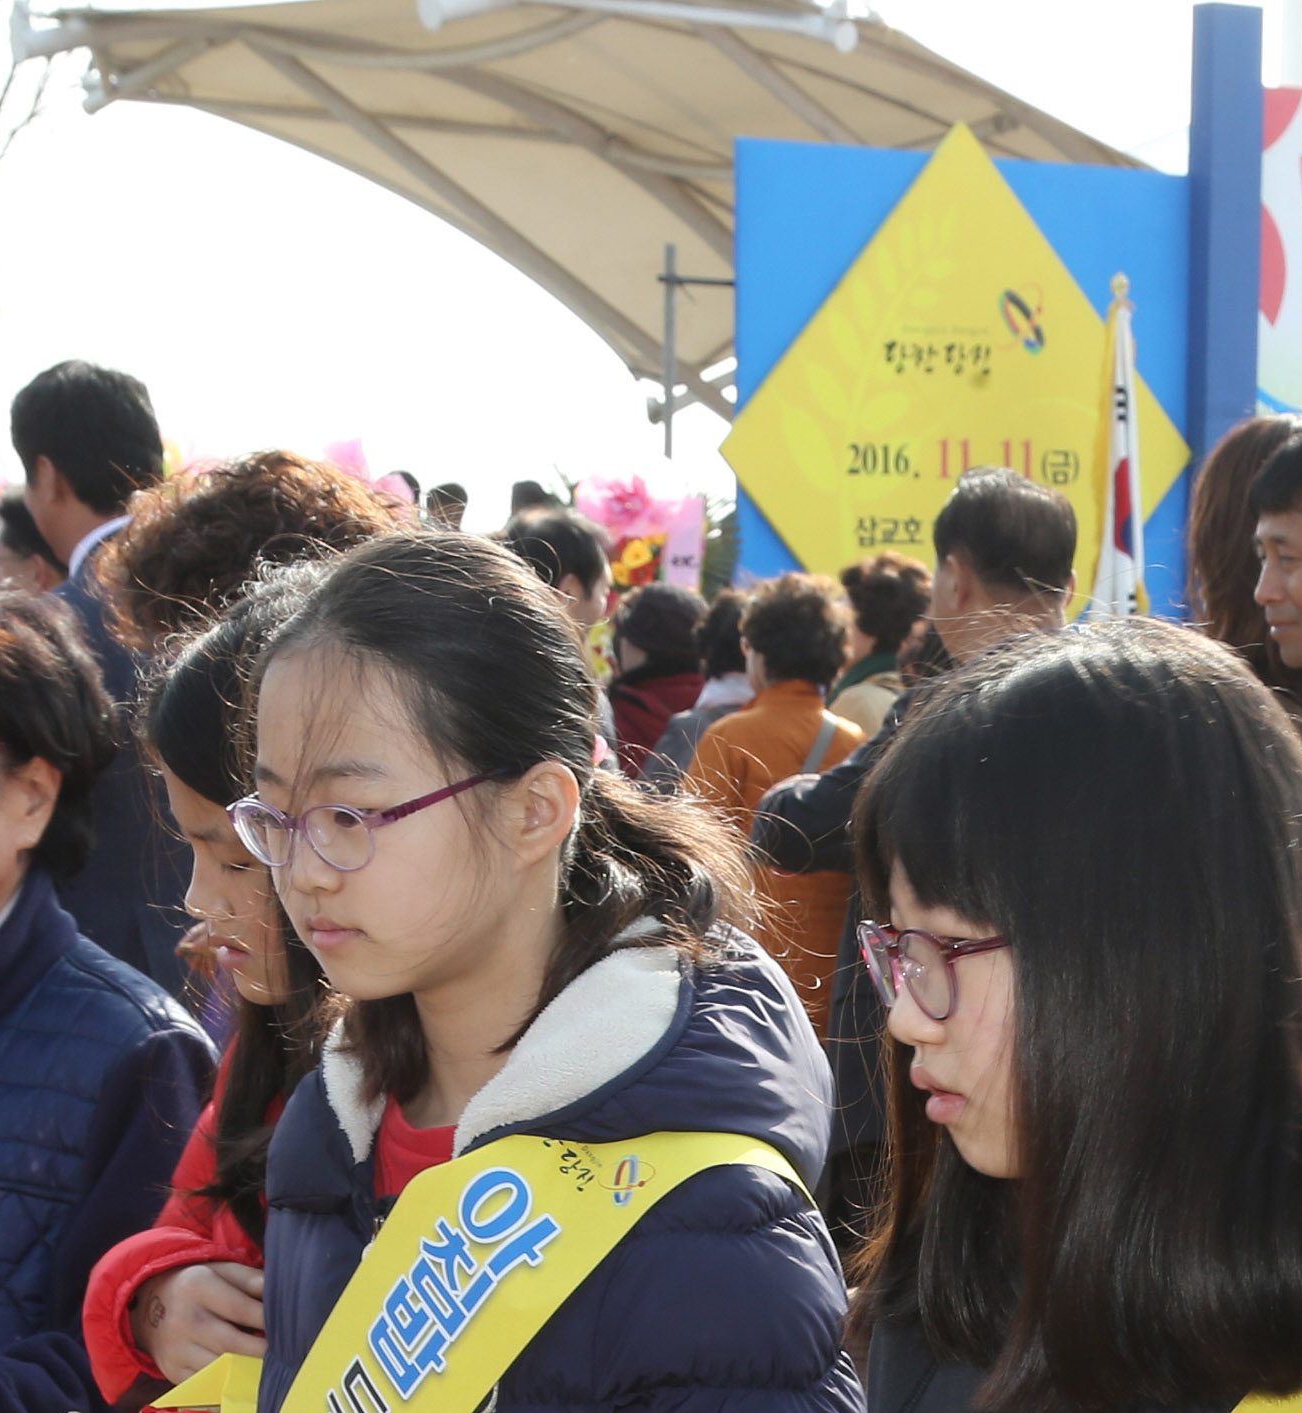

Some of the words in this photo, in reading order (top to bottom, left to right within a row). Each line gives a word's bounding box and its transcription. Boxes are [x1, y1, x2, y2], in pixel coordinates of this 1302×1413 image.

[847, 443, 920, 479] 2016.
[858, 516, 923, 548] 삽교호
[368, 1166, 562, 1400] 아침밥
